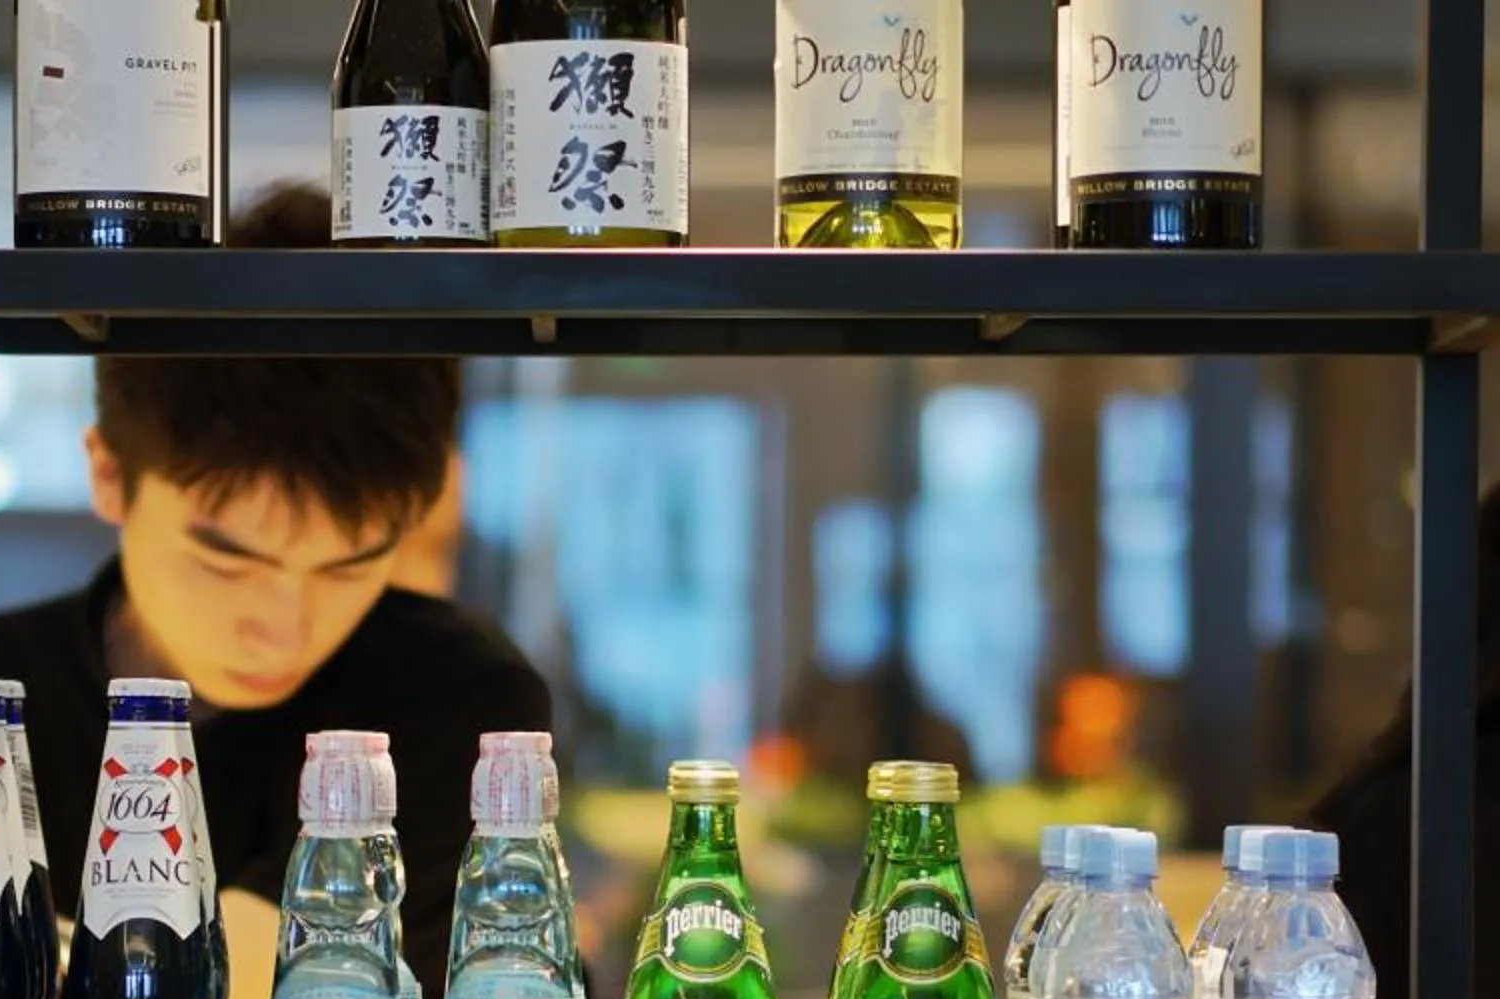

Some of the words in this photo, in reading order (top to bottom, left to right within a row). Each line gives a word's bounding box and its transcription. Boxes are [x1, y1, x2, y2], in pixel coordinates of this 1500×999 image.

[125, 57, 178, 71] GRAVEL
[792, 28, 938, 103] Dragonfly
[1090, 25, 1239, 101] Dragonfly
[834, 180, 898, 191] BRIDGE
[905, 182, 952, 194] ESTATE
[1133, 180, 1198, 191] BRIDGE
[1204, 181, 1251, 193] ESTATE
[29, 199, 79, 211] LLOW
[85, 198, 147, 210] BRIDGE
[152, 201, 198, 214] ESTATE
[107, 787, 176, 822] 1664
[91, 857, 191, 887] BLANC
[663, 899, 742, 957] perrier
[882, 902, 961, 959] perrier
